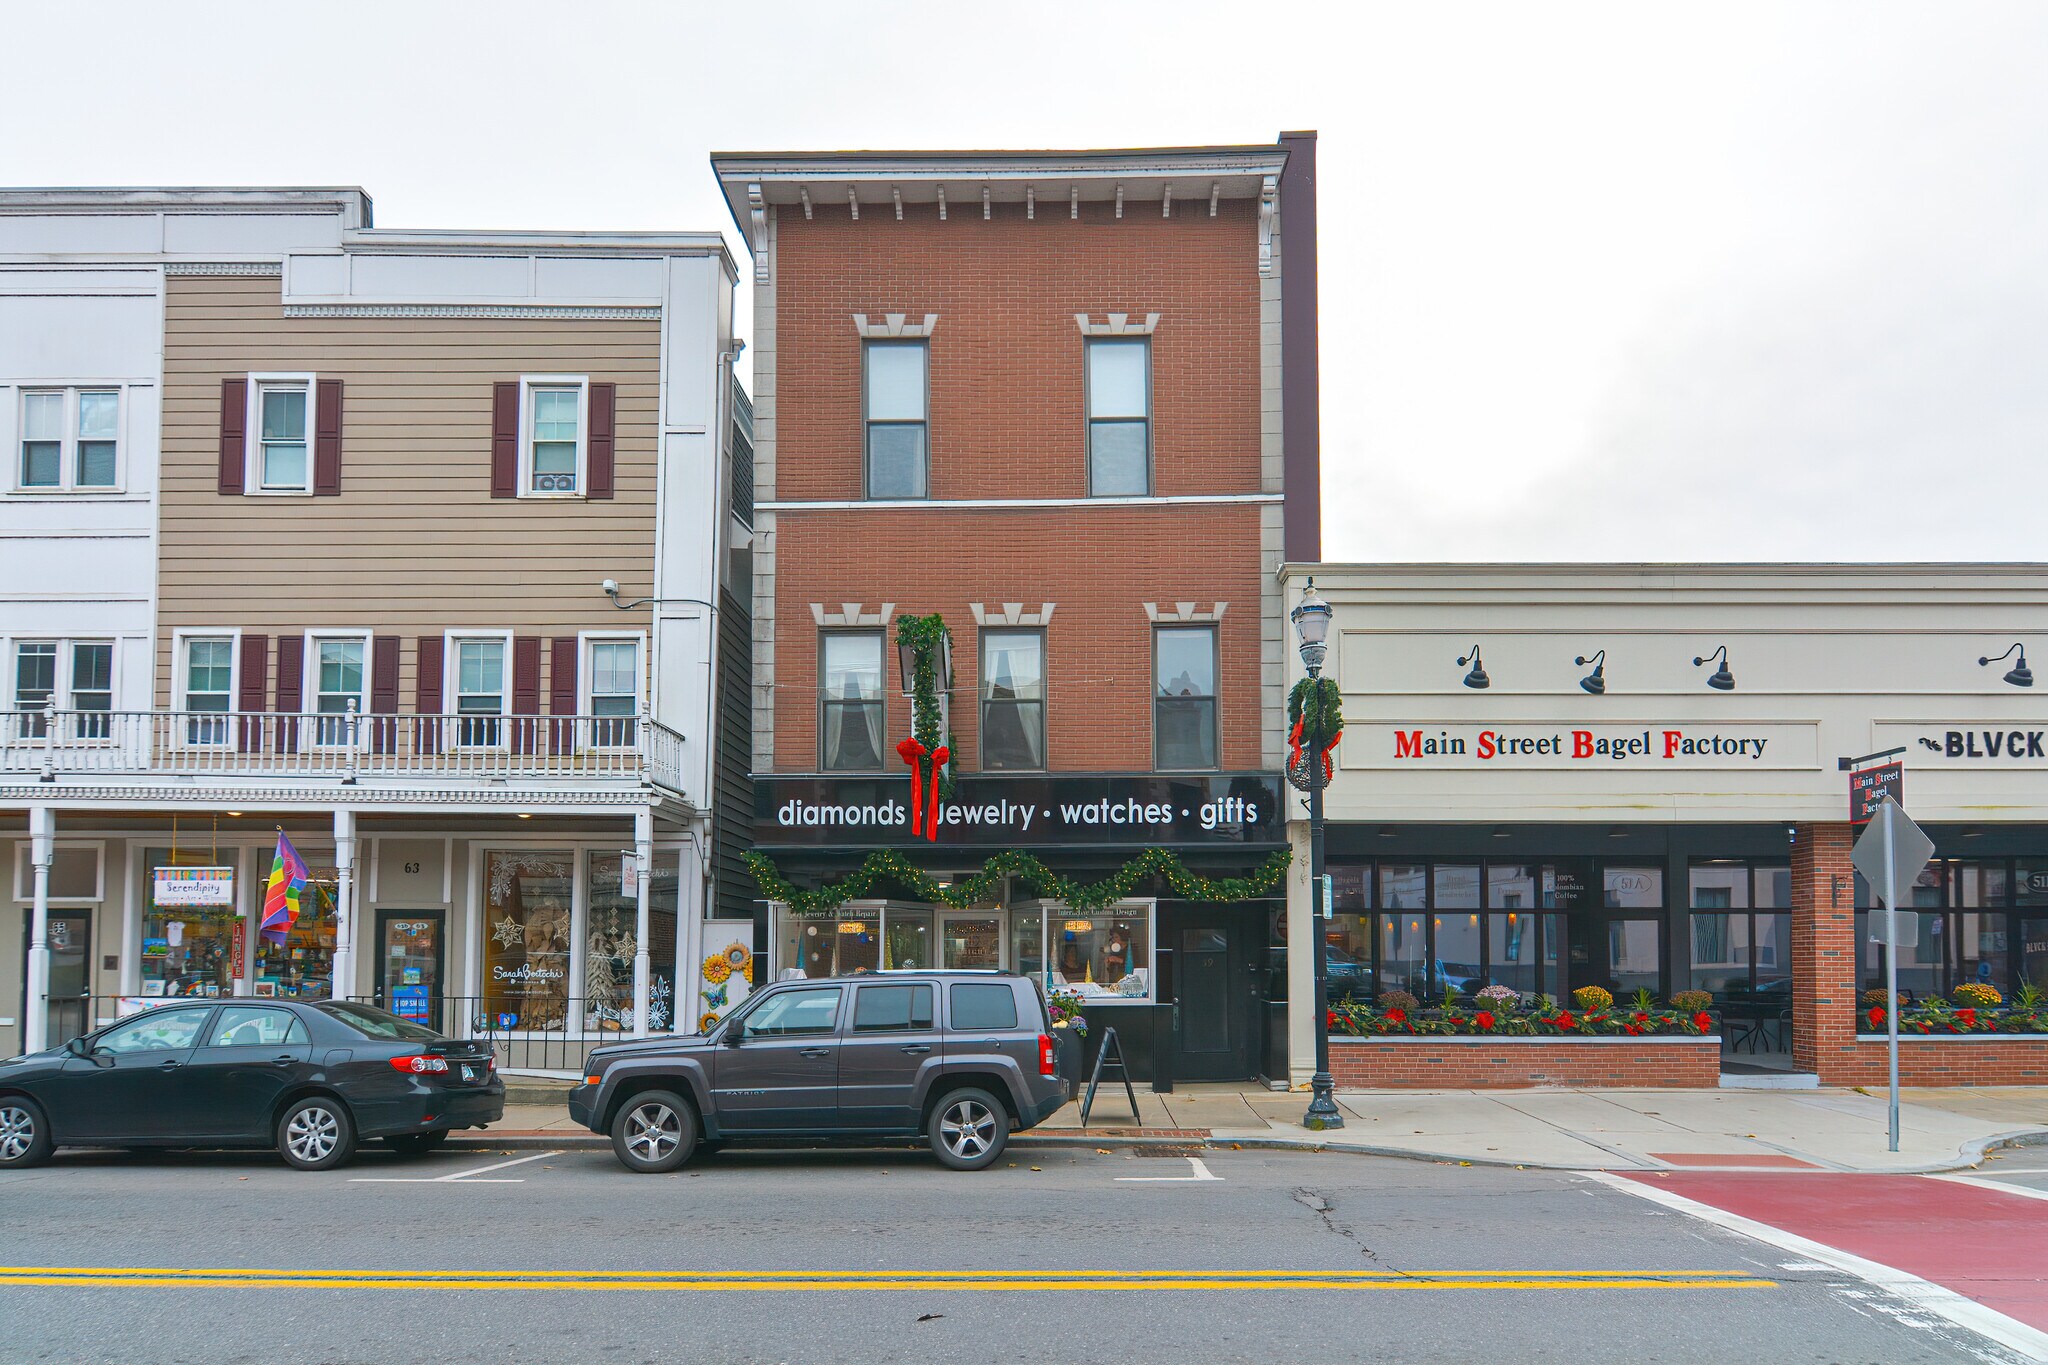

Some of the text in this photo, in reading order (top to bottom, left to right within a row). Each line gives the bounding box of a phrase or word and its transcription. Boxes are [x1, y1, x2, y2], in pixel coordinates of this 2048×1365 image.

[1394, 730, 1769, 760] Main Street Bagel Factory
[1945, 731, 2045, 758] BLVCK
[1853, 771, 1899, 790] Main Street
[1865, 785, 1887, 801] Bagel
[778, 799, 906, 825] diamonds
[1060, 797, 1173, 824] watches
[1200, 797, 1258, 829] gifts
[404, 862, 420, 874] 63
[167, 881, 220, 895] Serendipity
